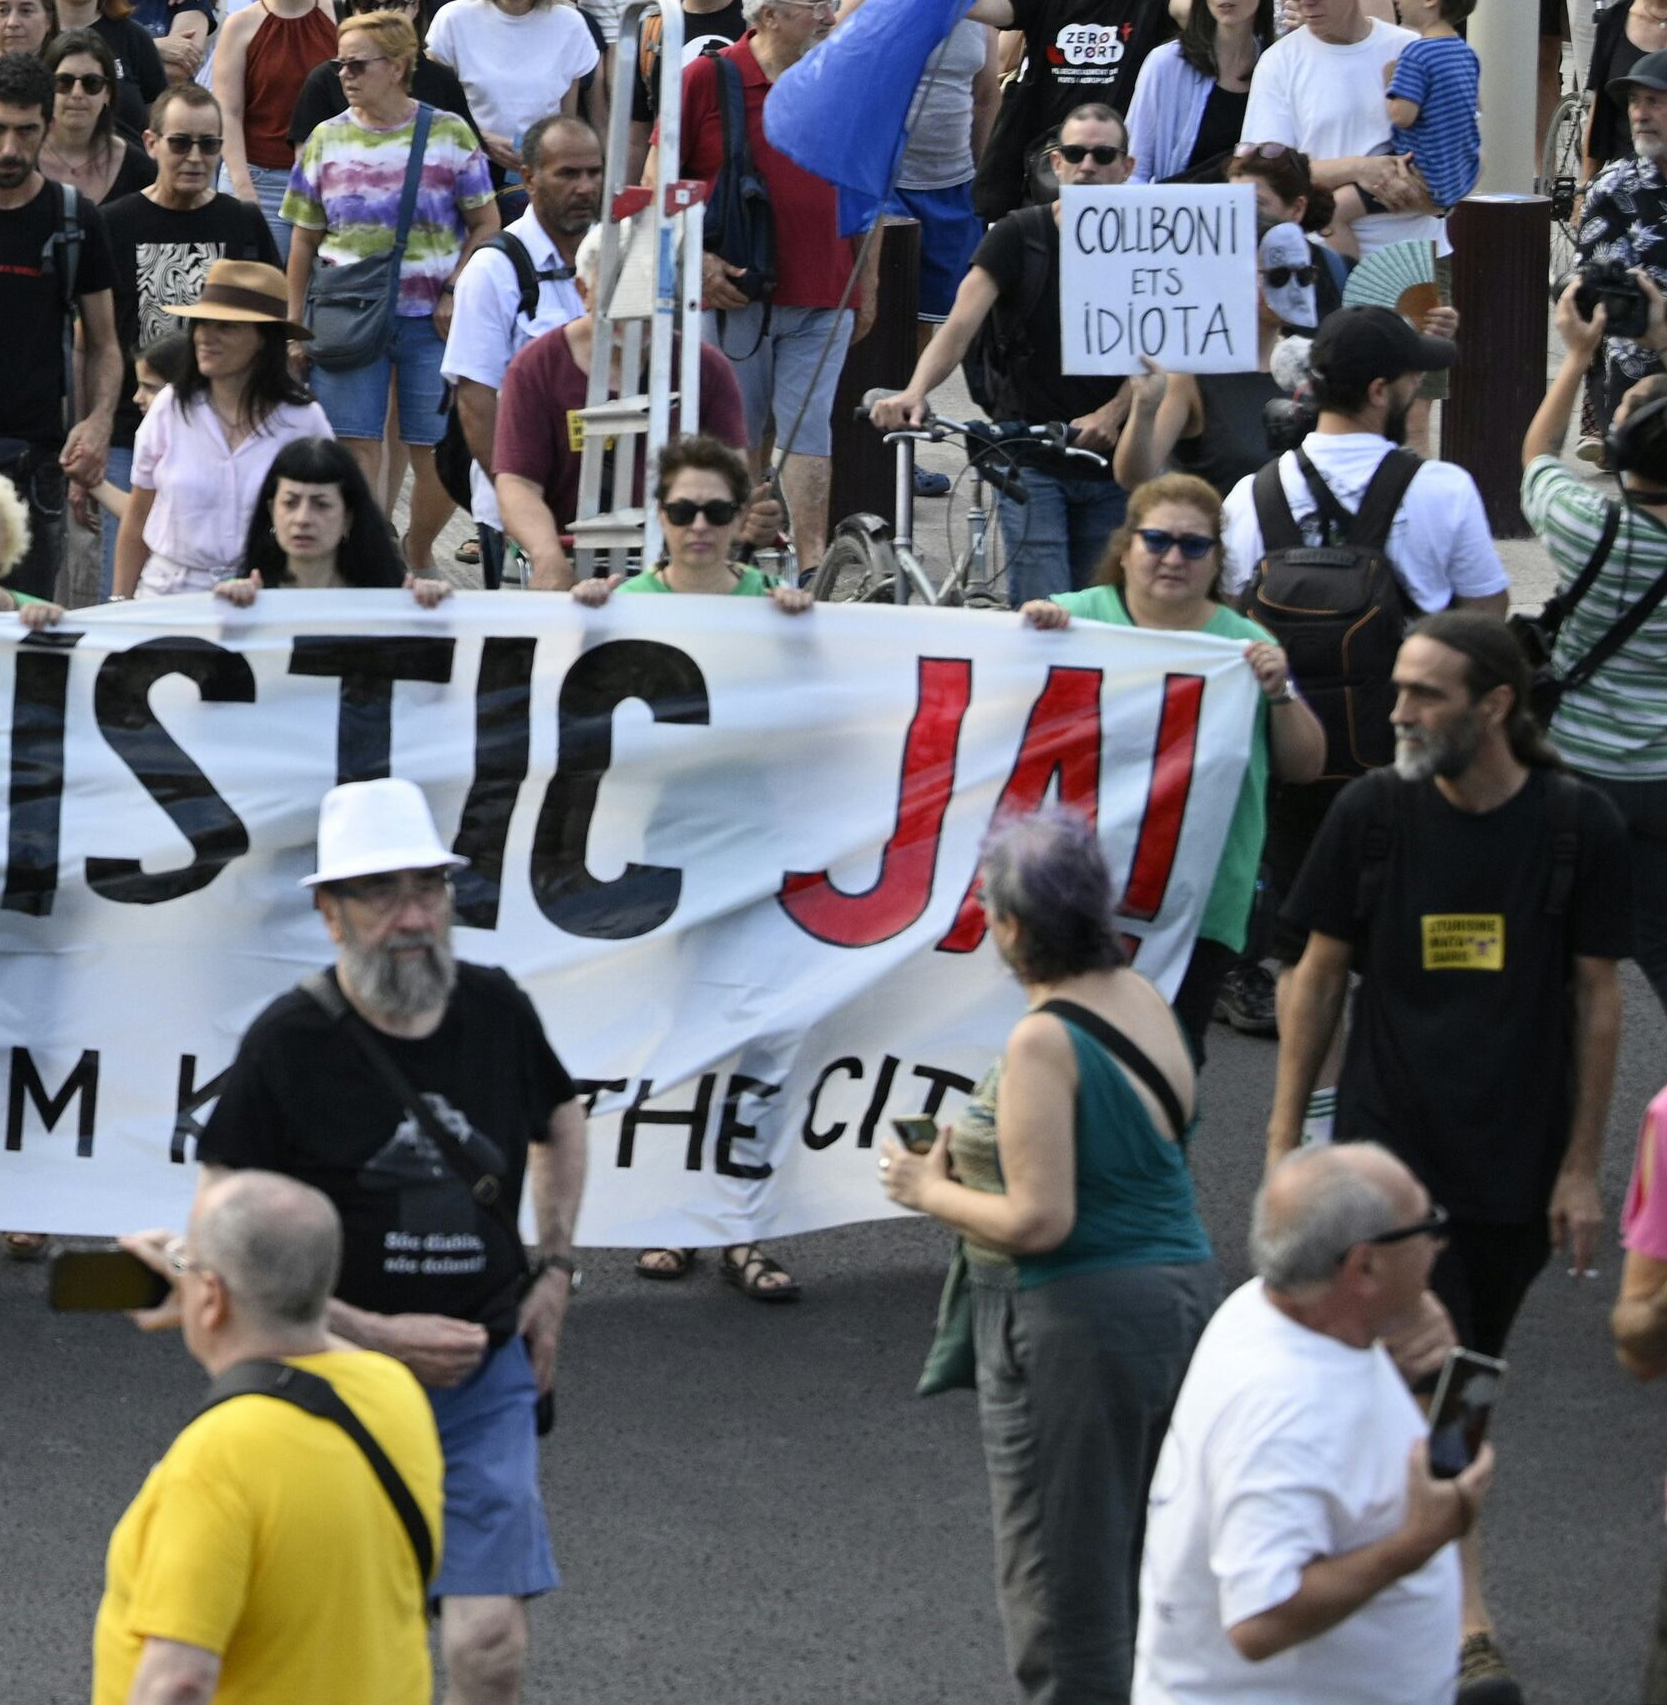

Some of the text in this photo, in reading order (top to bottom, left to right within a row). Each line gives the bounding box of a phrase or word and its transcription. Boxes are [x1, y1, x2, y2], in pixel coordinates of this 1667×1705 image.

[1066, 31, 1111, 45] ZERO
[1072, 44, 1118, 60] PORT
[1074, 200, 1238, 257] COLLBONI
[1131, 267, 1184, 297] ETS
[1083, 301, 1235, 357] IDIOTA
[776, 653, 1208, 958] JA!
[801, 1054, 980, 1150] CIT
